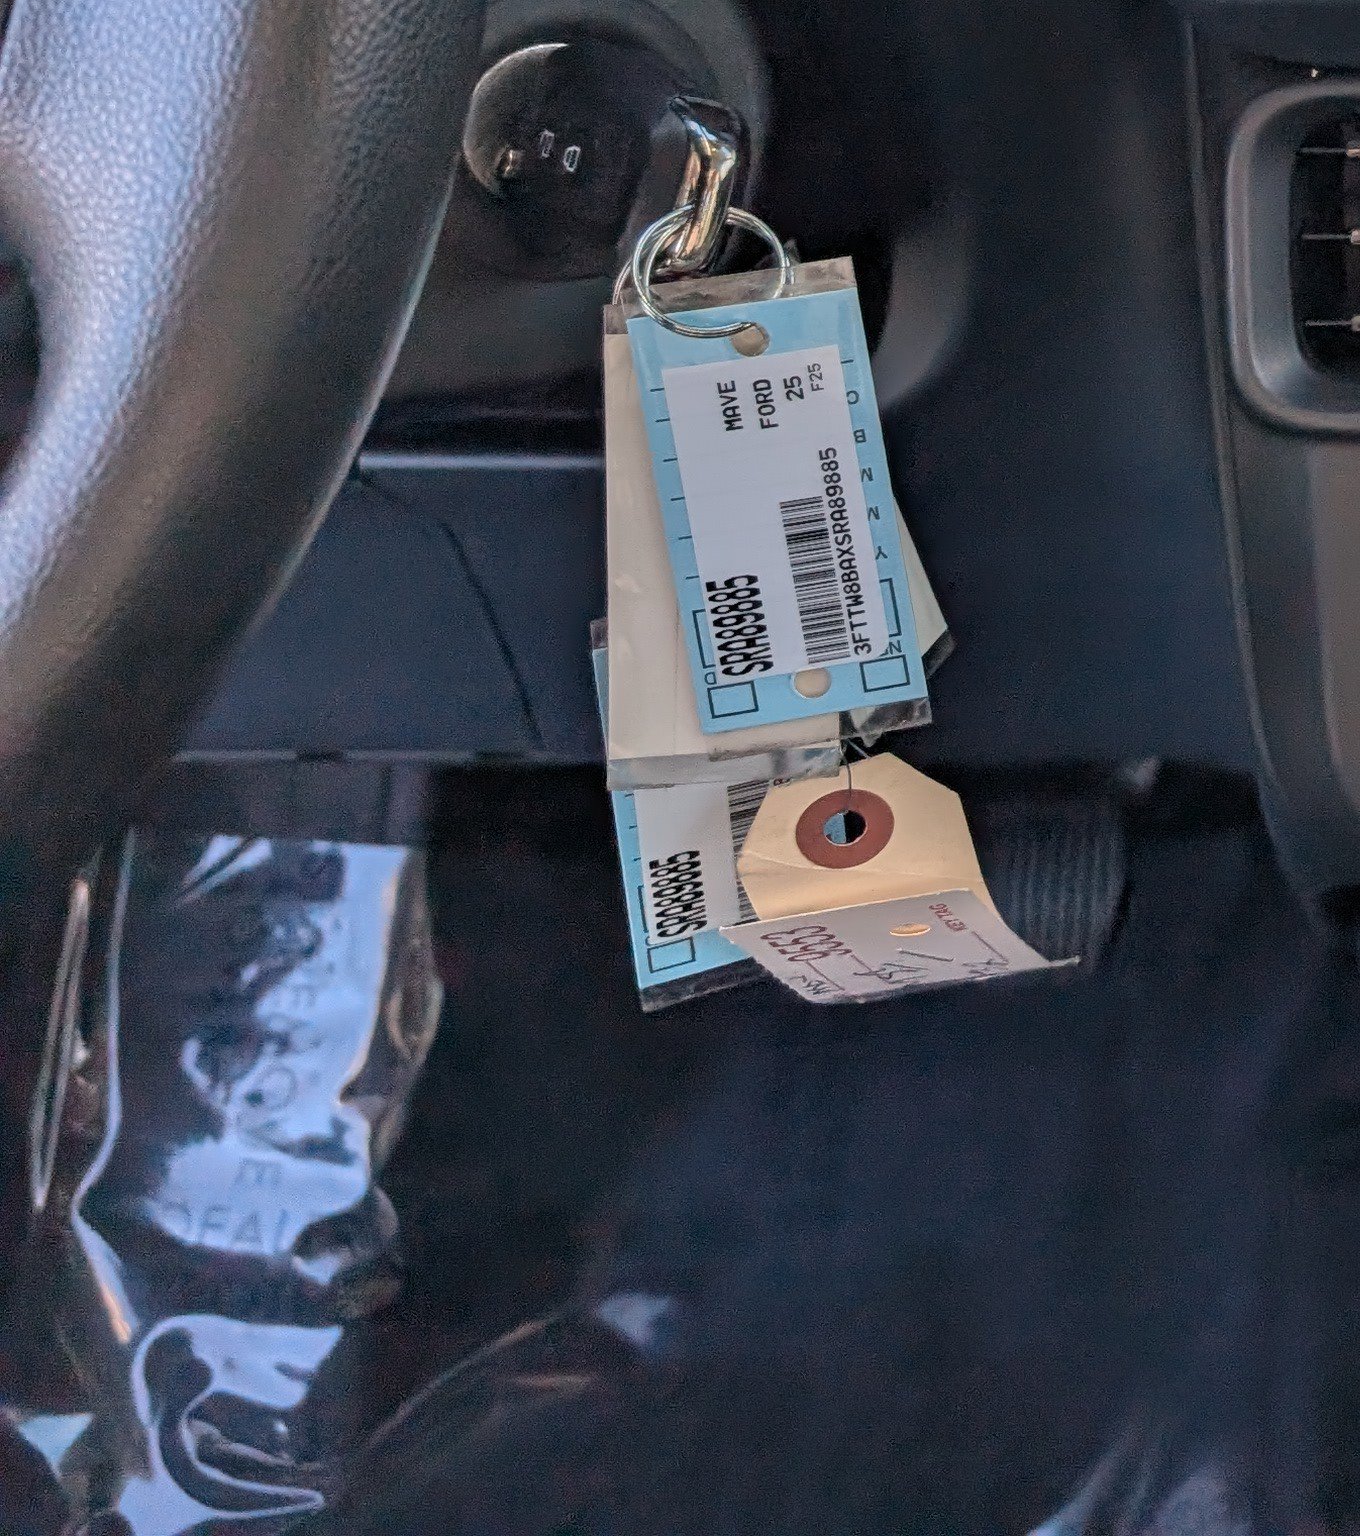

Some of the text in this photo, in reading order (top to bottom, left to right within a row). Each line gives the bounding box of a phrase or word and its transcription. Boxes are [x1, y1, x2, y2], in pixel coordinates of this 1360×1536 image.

[783, 375, 804, 401] 25
[807, 362, 824, 392] F25
[717, 379, 744, 432] MAVE
[753, 378, 779, 430] FORD
[819, 446, 872, 656] 3FTTW8BAXSRA89885
[705, 574, 774, 677] SRA89885
[649, 850, 707, 938] SRA89885
[928, 903, 968, 932] KEY TAG
